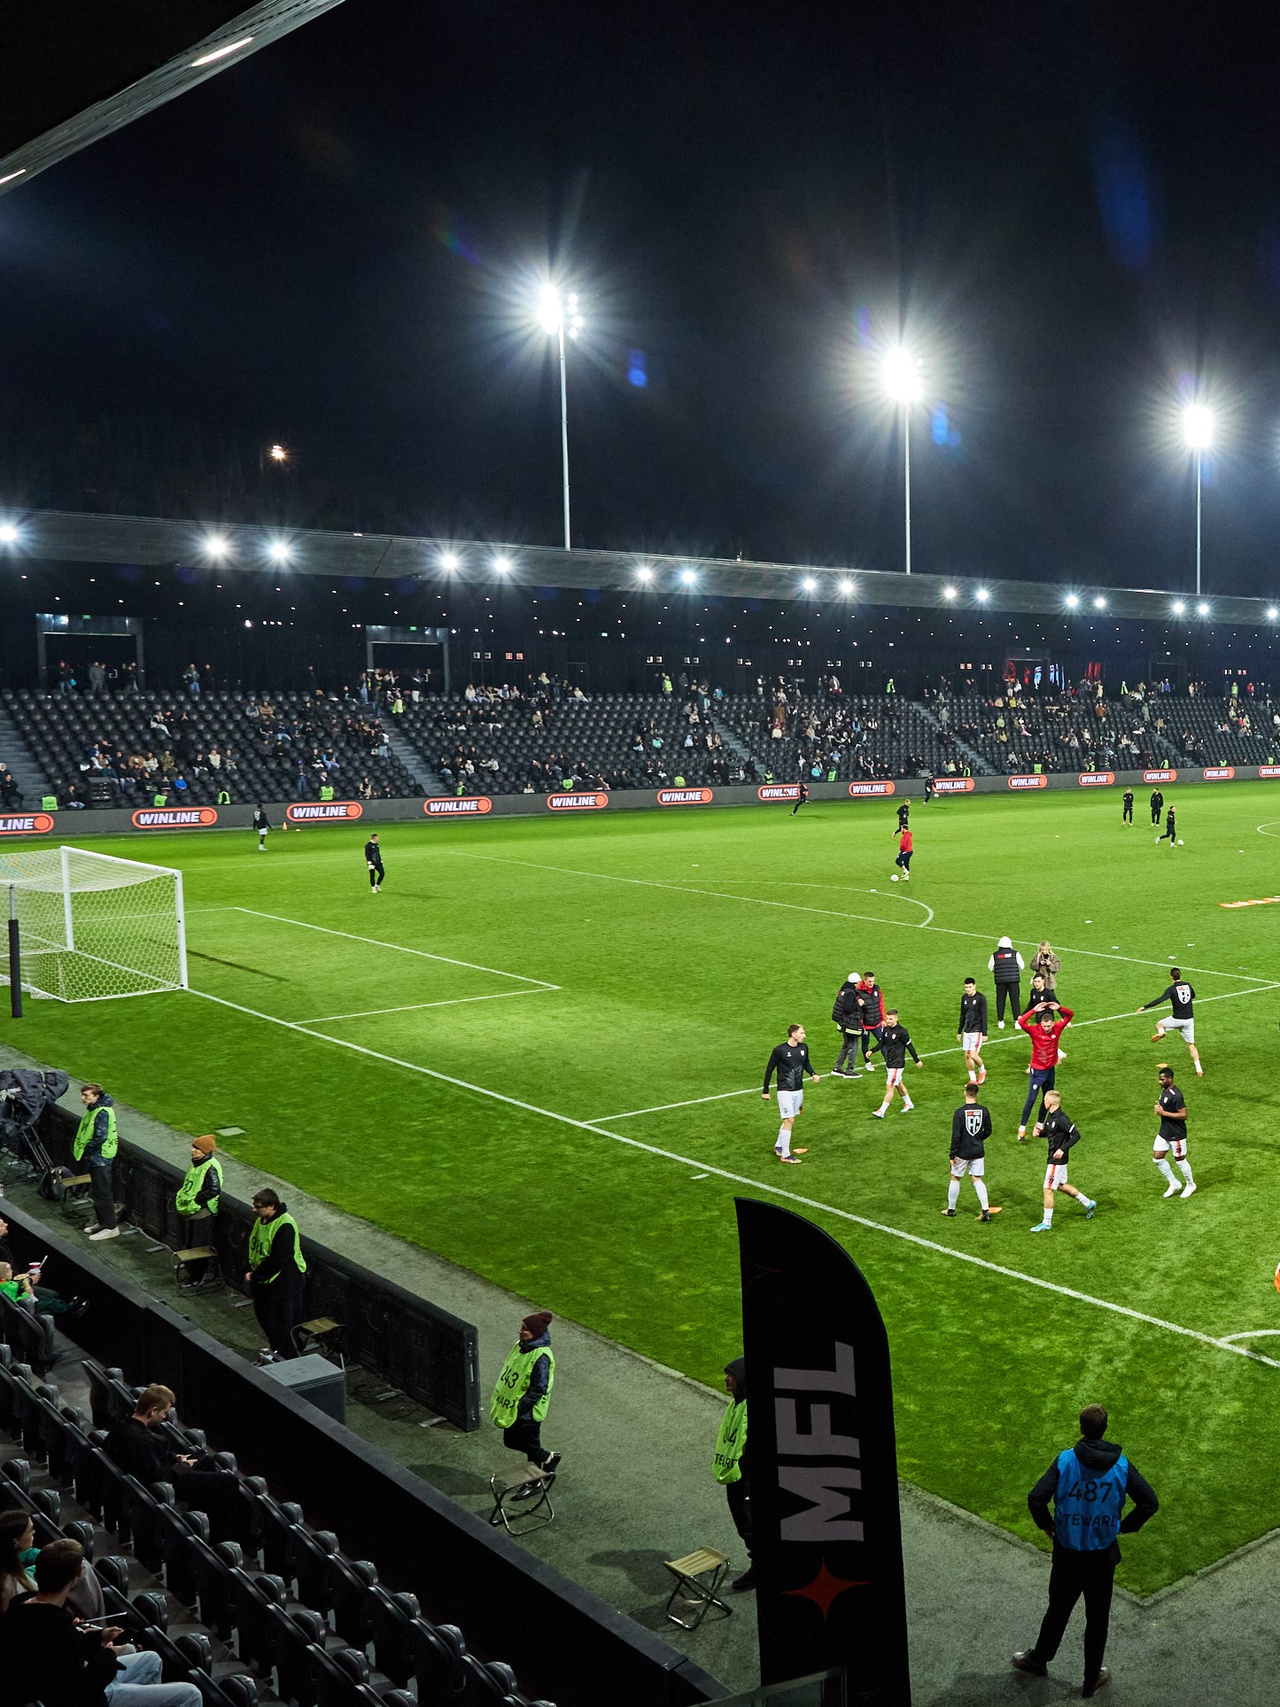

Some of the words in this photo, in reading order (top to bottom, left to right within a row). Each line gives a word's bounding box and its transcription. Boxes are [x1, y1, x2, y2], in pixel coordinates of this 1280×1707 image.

[1012, 778, 1039, 786] WINLINE
[1082, 775, 1107, 784] WINLINE
[853, 784, 885, 793] WINLINE
[937, 781, 965, 790] WINLINE
[552, 796, 595, 807] WINLINE
[662, 791, 700, 802] WINLINE
[293, 805, 347, 817] WINLINE
[430, 801, 477, 812] WINLINE
[139, 811, 200, 824] WINLINE
[0, 818, 35, 831] LINE
[774, 1341, 864, 1542] MFL
[1068, 1480, 1113, 1503] 487
[1063, 1513, 1118, 1528] TEWARD
